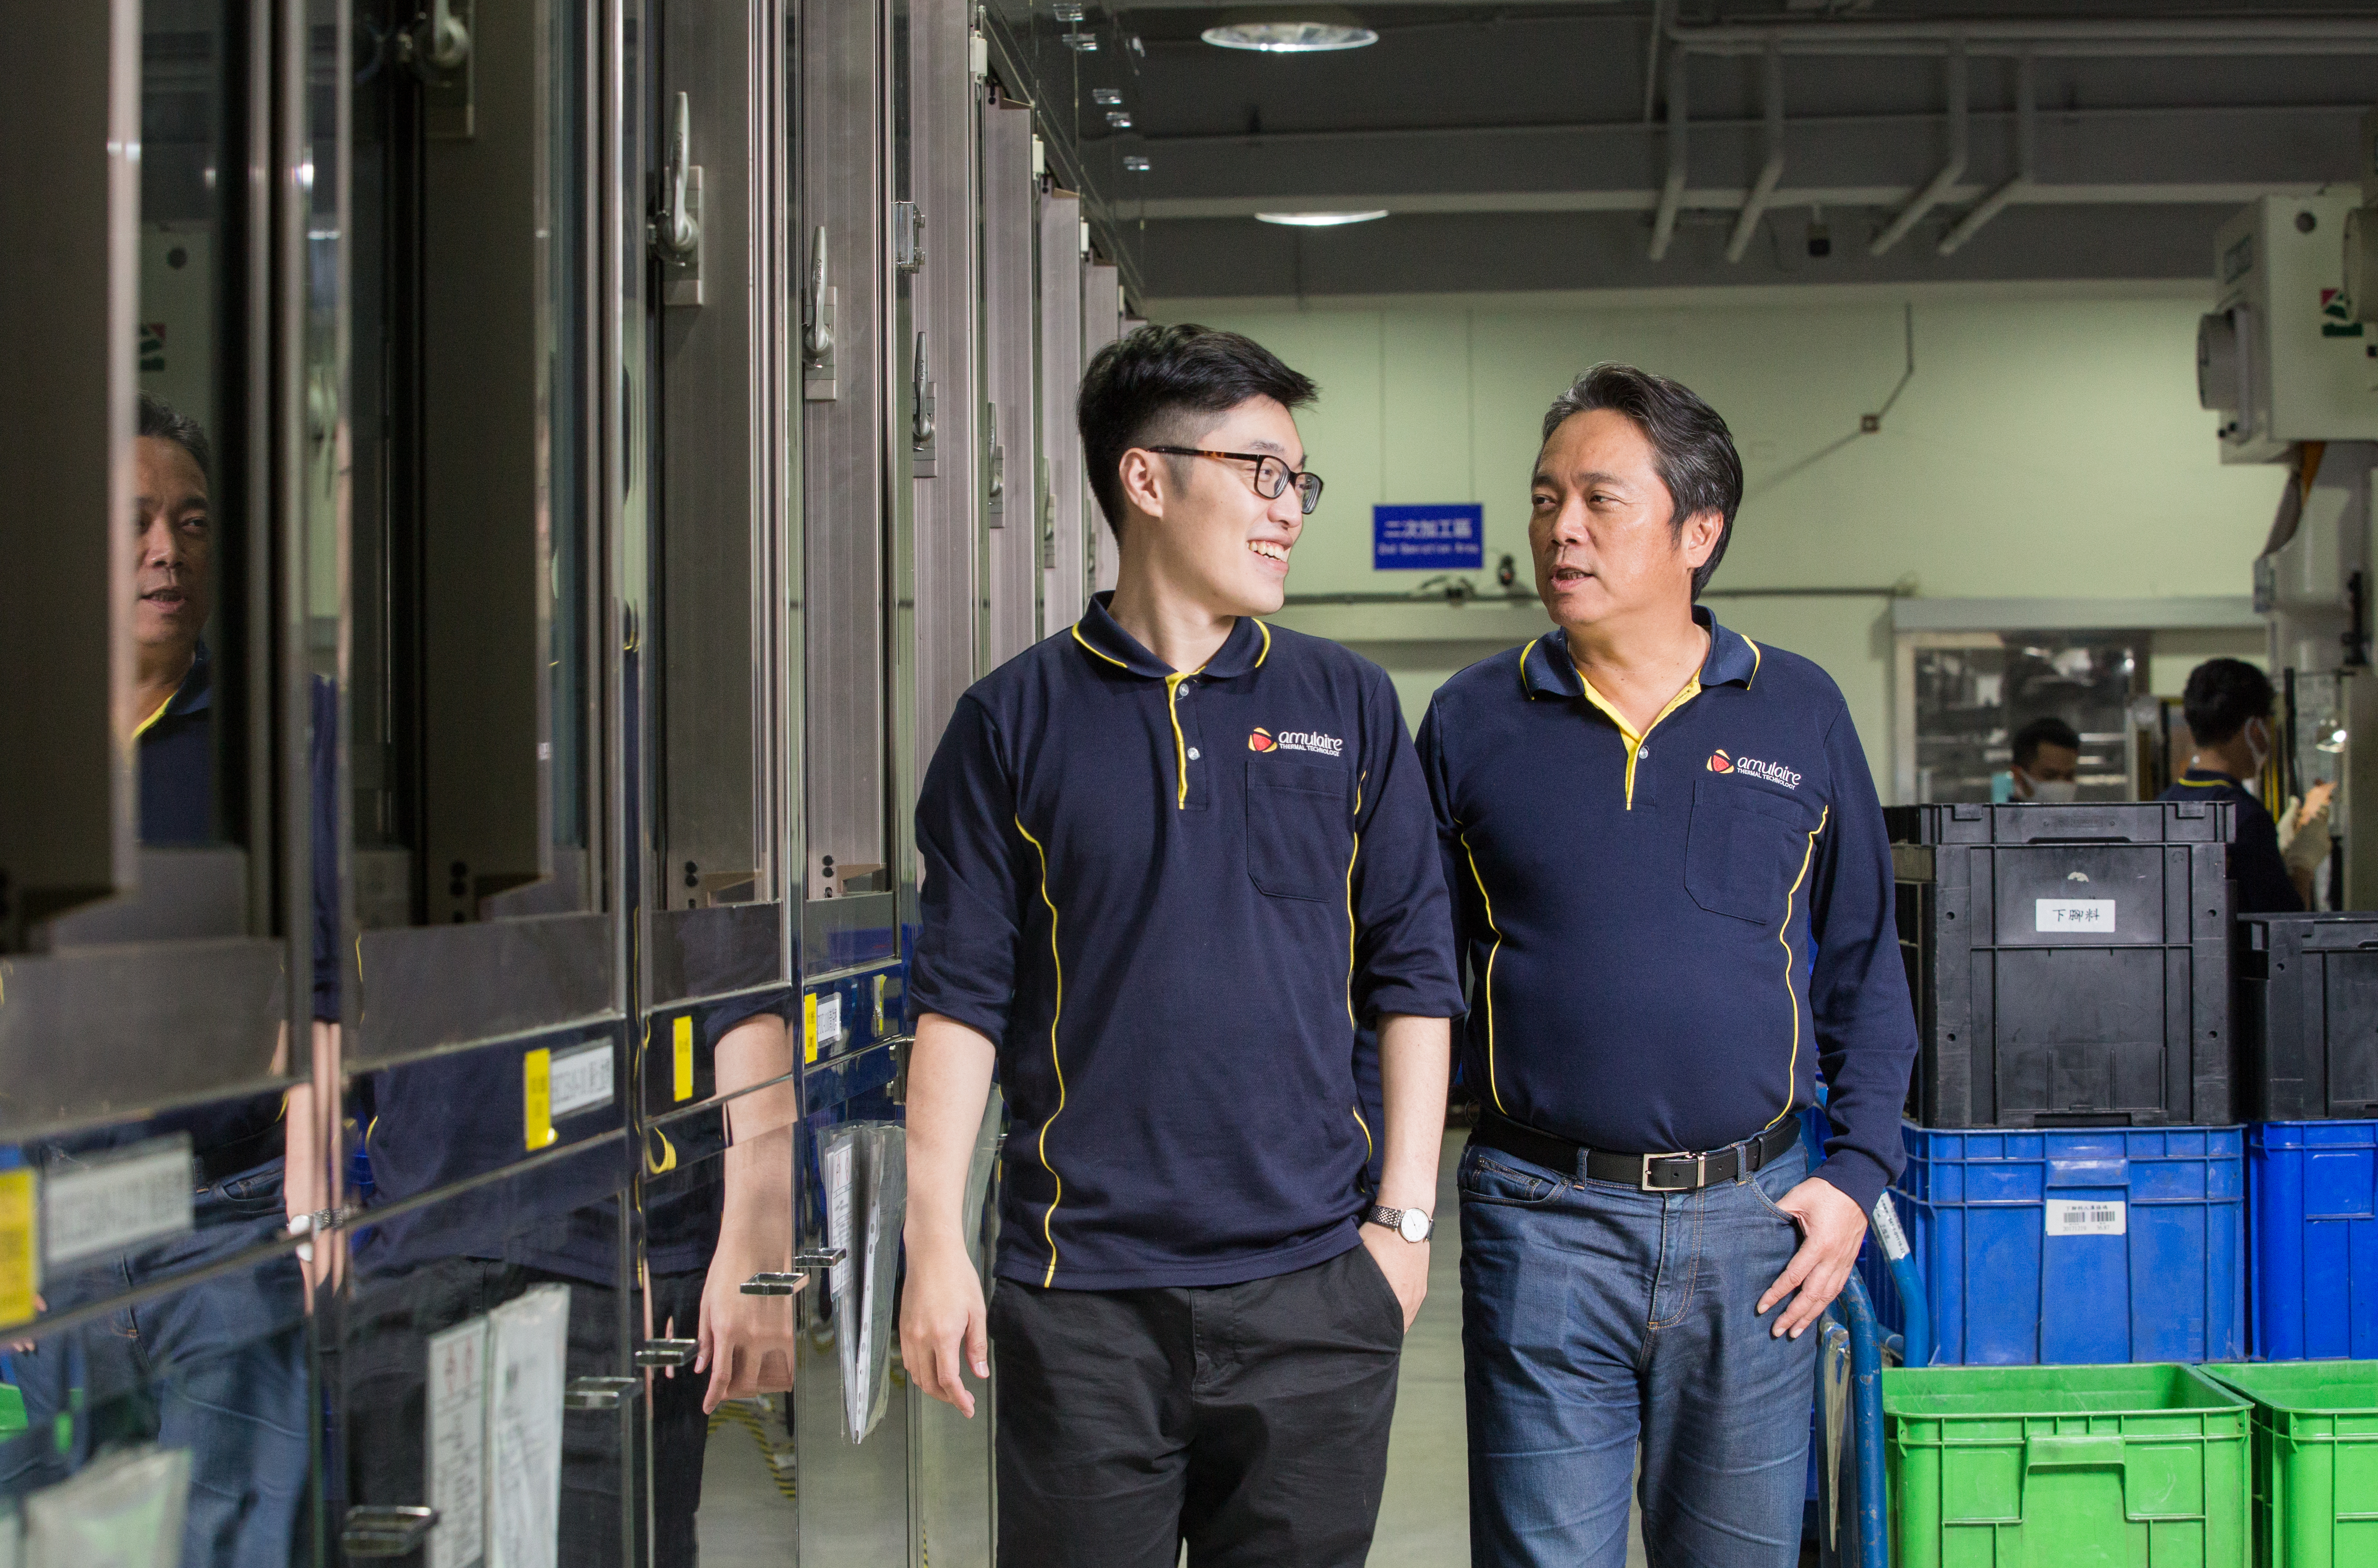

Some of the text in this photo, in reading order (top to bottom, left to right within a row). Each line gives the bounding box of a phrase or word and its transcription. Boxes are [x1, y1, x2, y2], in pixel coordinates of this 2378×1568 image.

[1278, 731, 1343, 751] amulaire
[1307, 746, 1340, 757] TECHNOLOGY
[1737, 757, 1802, 785] amulaire
[1737, 767, 1796, 790] THERMAL TECHNOLOGY
[2052, 908, 2100, 922] 下腳料
